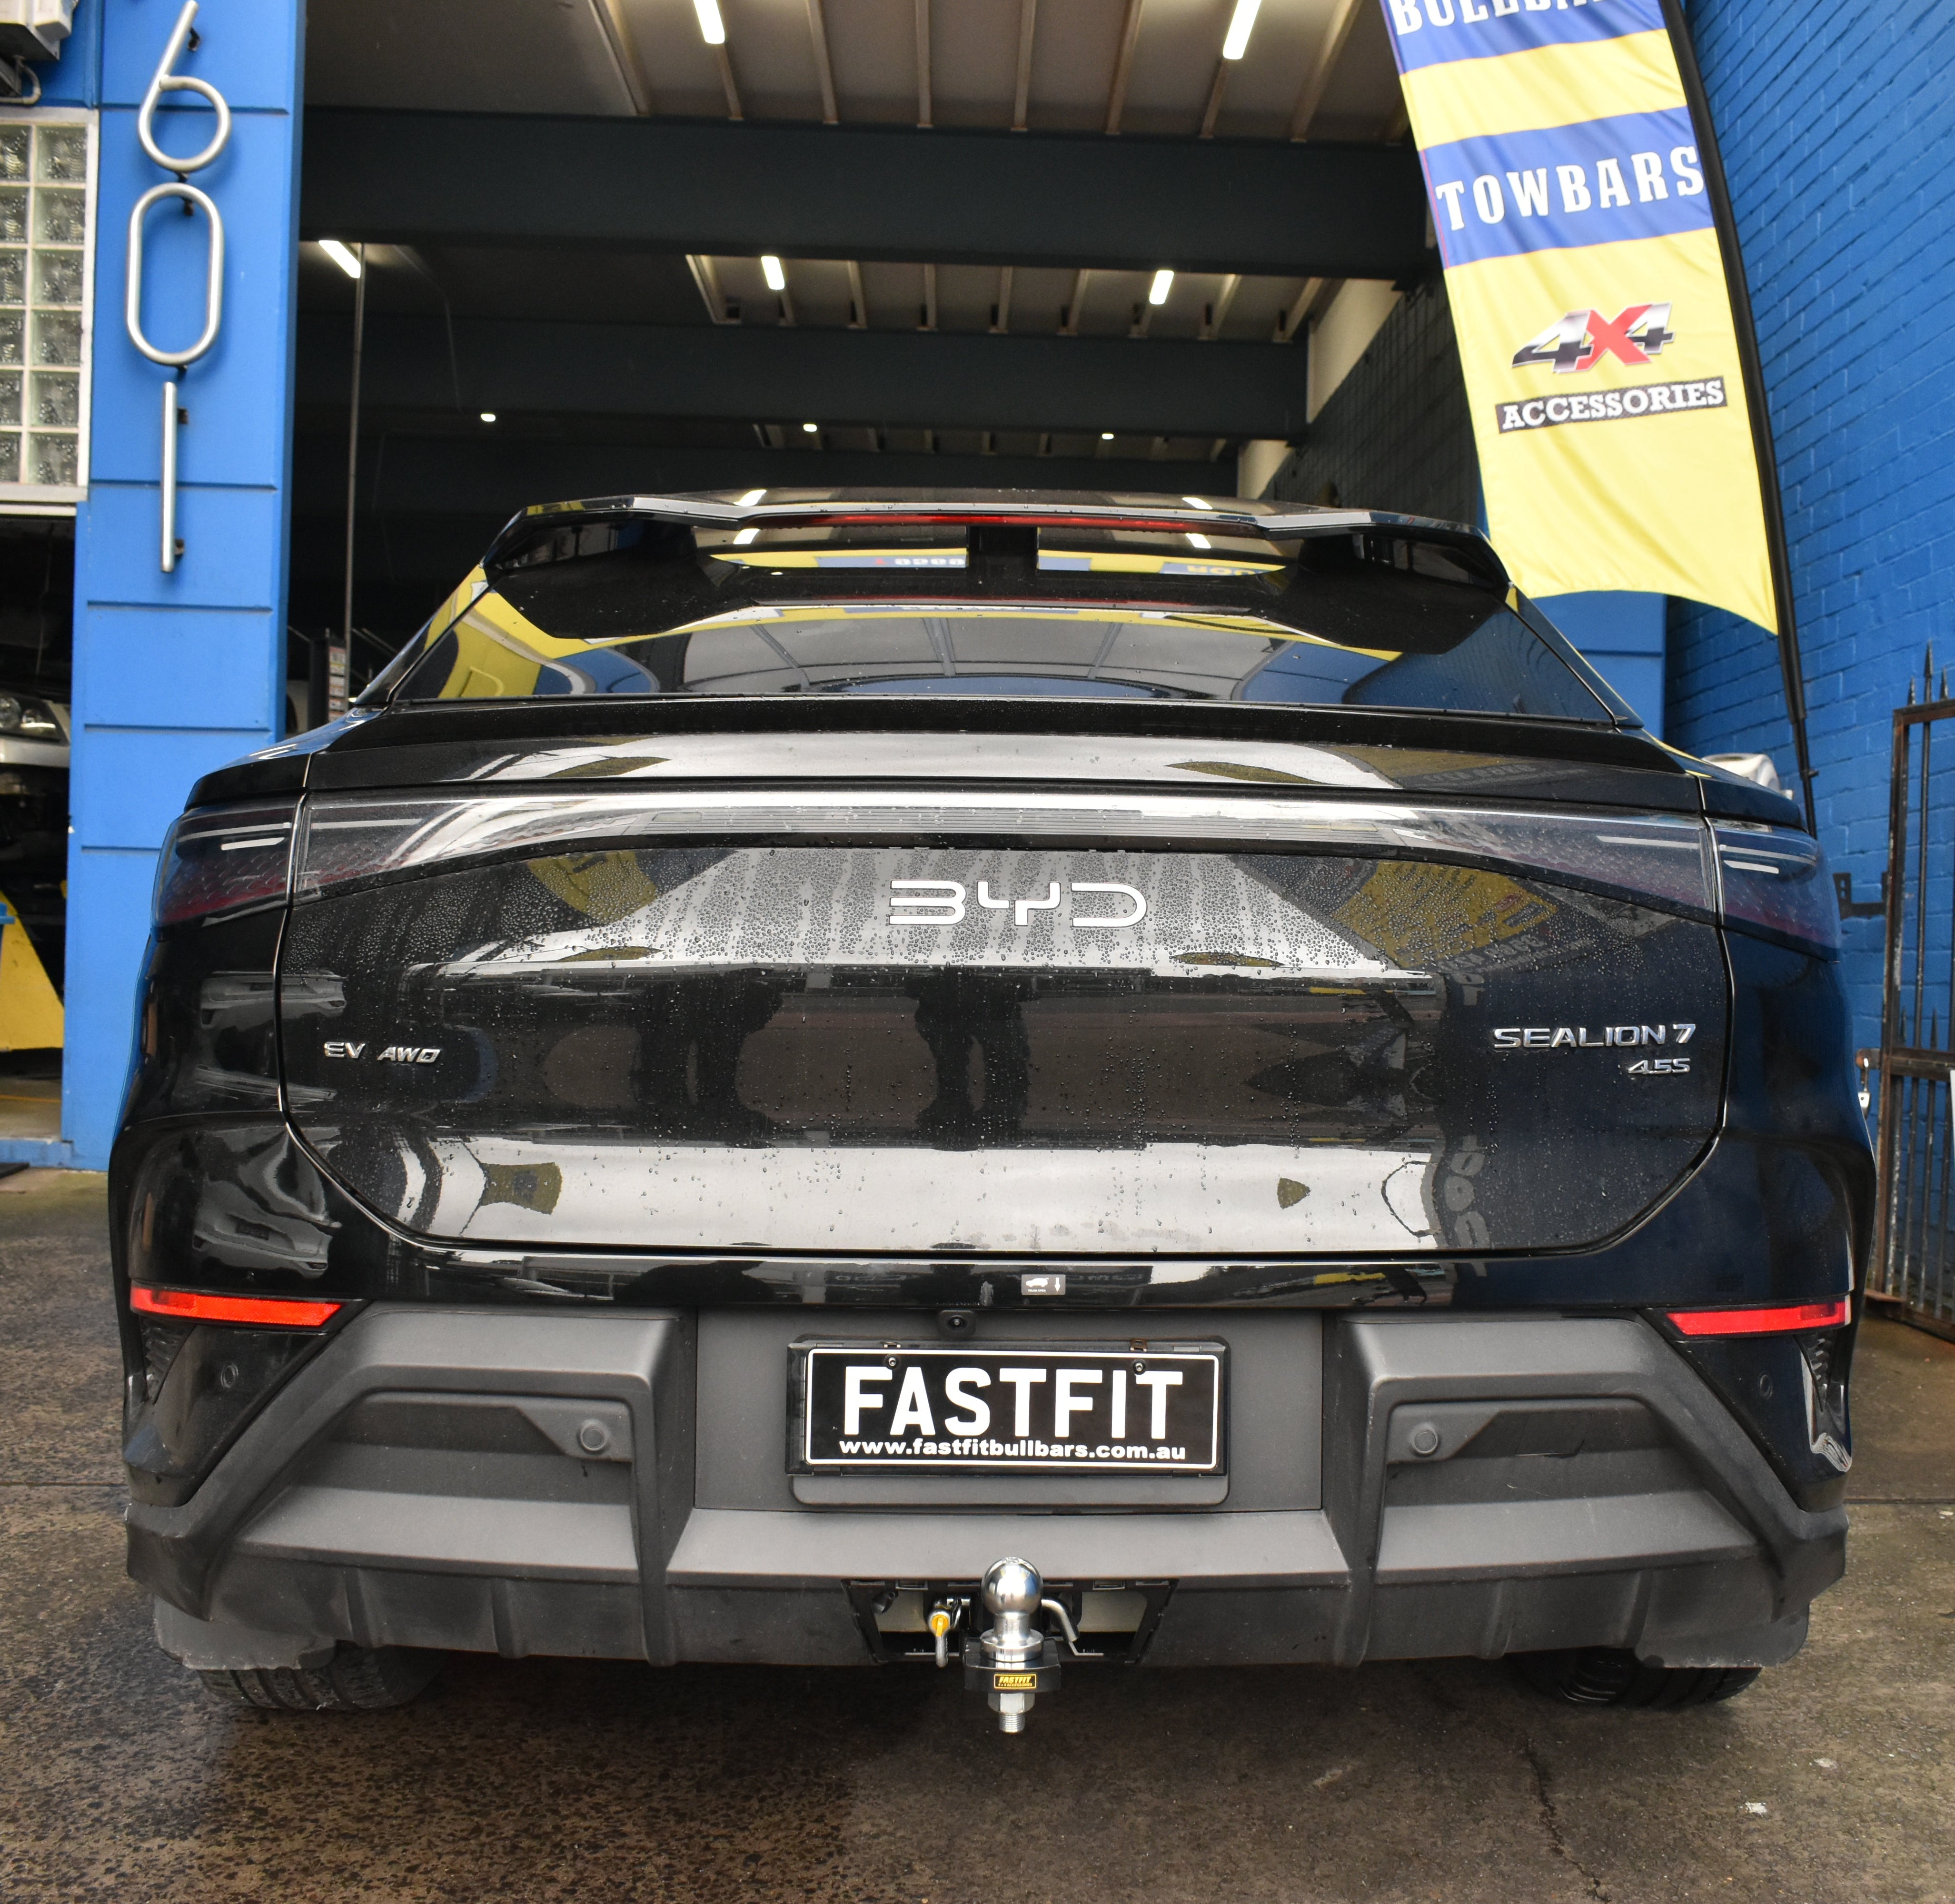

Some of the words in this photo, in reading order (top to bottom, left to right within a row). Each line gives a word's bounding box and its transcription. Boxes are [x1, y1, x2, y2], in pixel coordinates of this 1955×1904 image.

[1435, 146, 1704, 231] TOWBARS
[1502, 379, 1724, 429] ACCESSORIES
[889, 880, 1147, 927] BYD
[324, 1041, 366, 1059] EV
[377, 1046, 441, 1063] AWD
[1494, 1024, 1666, 1048] SEALION
[1672, 1023, 1697, 1044] 7
[844, 1366, 1183, 1439] FASTFIT
[839, 1438, 1186, 1460] www.fastfitbullbars.com.au
